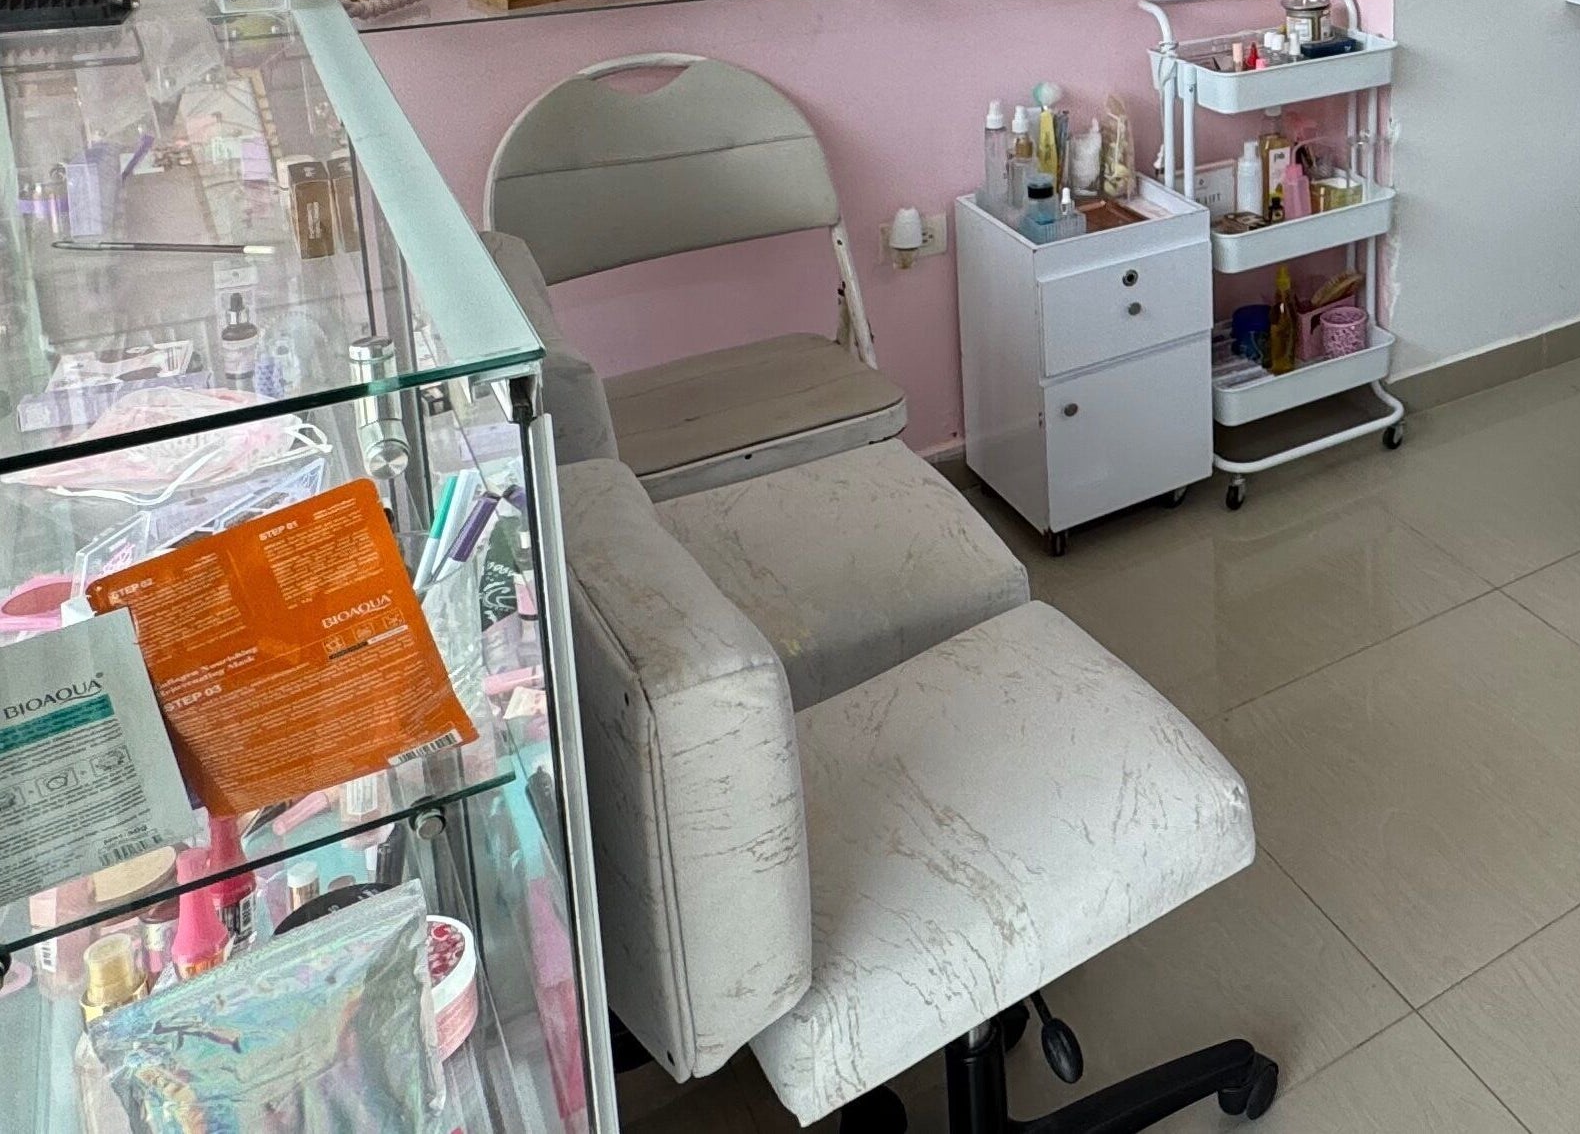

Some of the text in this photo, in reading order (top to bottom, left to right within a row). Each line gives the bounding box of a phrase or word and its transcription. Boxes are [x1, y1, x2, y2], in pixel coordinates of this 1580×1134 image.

[321, 595, 393, 629] BIOAQUA
[3, 677, 104, 721] BIOAQUA
[163, 684, 223, 713] STEP 03
